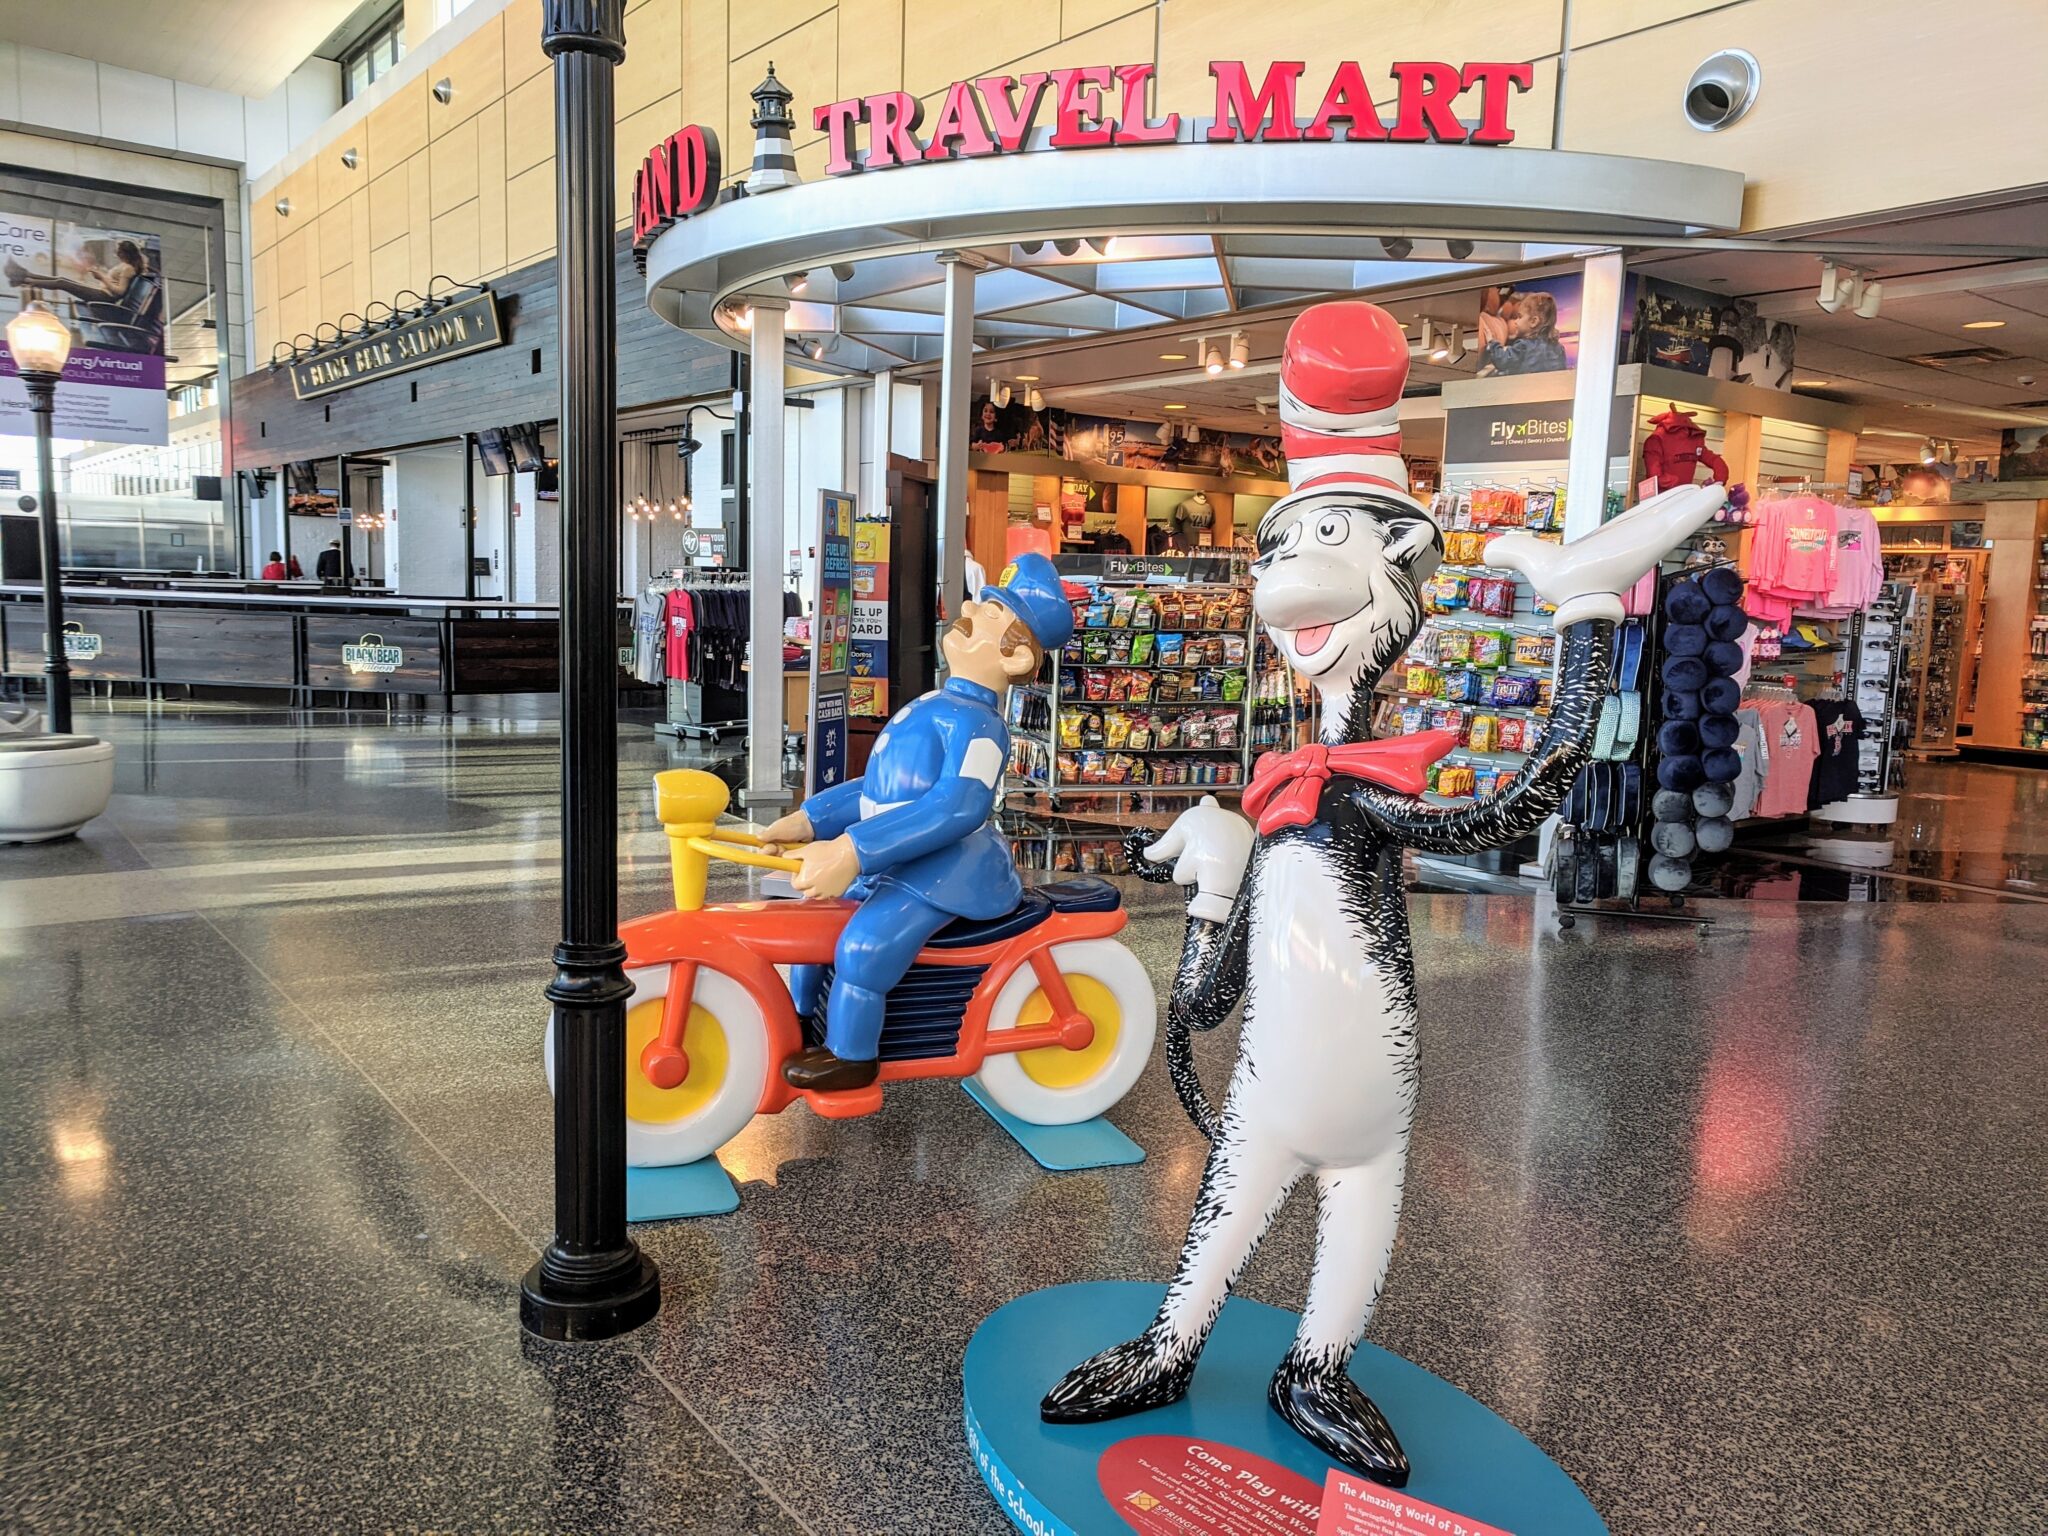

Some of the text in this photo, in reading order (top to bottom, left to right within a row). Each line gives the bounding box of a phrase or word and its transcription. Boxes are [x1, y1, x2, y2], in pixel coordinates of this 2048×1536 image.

[813, 62, 1180, 176] TRAVEL
[1206, 60, 1534, 145] MART
[309, 315, 468, 386] BLACK BEAR SALOON
[1109, 431, 1125, 442] 95
[1491, 419, 1567, 440] Fly Bites
[1110, 561, 1165, 574] Fly Bites
[869, 608, 882, 616] UP
[345, 648, 399, 663] BLACK BEAR
[818, 707, 842, 719] CASH BACK
[980, 1452, 989, 1472] of
[990, 1464, 1005, 1497] the
[1007, 1488, 1056, 1536] School
[1184, 1459, 1212, 1478] Visit
[1211, 1476, 1232, 1490] the
[1231, 1488, 1289, 1521] Amazing
[1186, 1445, 1321, 1521] Come Play with
[1181, 1472, 1299, 1536] of Dr. Seuss Museu
[1184, 1503, 1217, 1525] Worth
[1338, 1481, 1357, 1497] The
[1358, 1490, 1402, 1518] Amazing
[1405, 1506, 1436, 1527] World
[1438, 1520, 1452, 1532] of
[1344, 1502, 1357, 1513] The
[1155, 1504, 1212, 1536] SPRINGFIE
